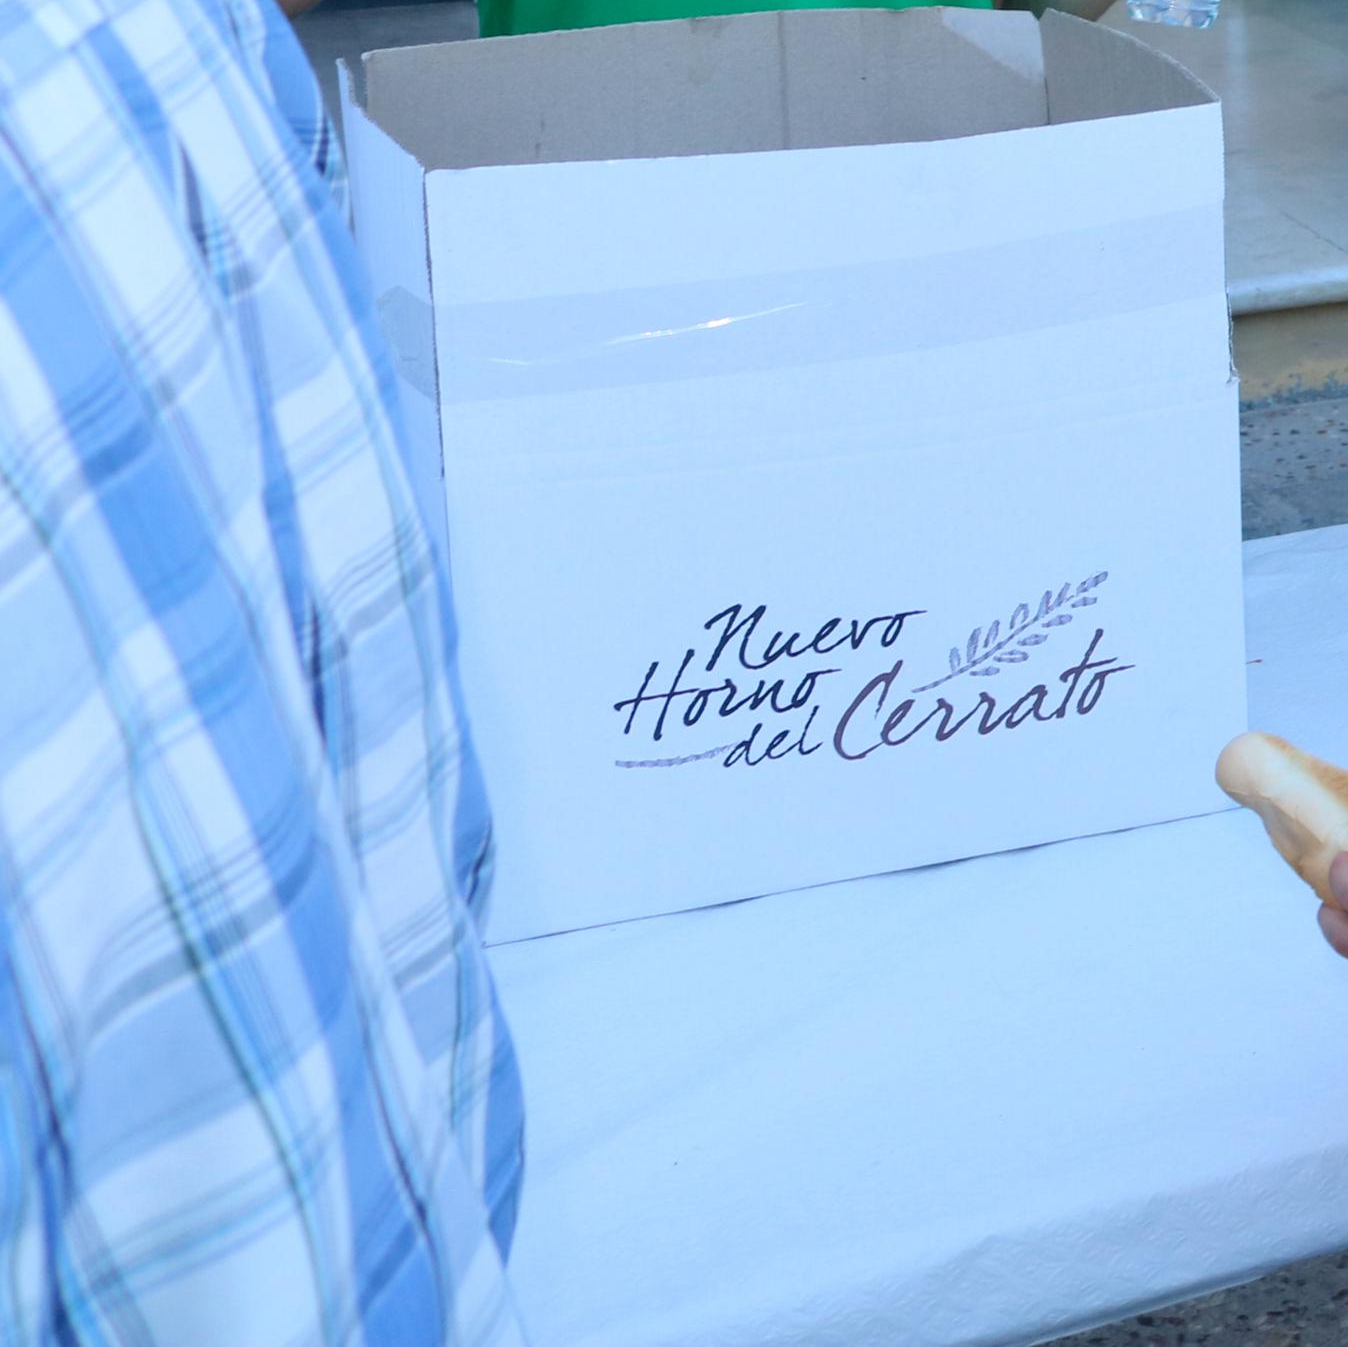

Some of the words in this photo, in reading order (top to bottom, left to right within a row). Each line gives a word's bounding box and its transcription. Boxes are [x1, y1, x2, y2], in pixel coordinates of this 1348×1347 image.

[704, 603, 928, 672] Nuevo
[613, 649, 842, 740] Horno
[722, 705, 824, 768] del
[833, 628, 1136, 761] Cerrato
